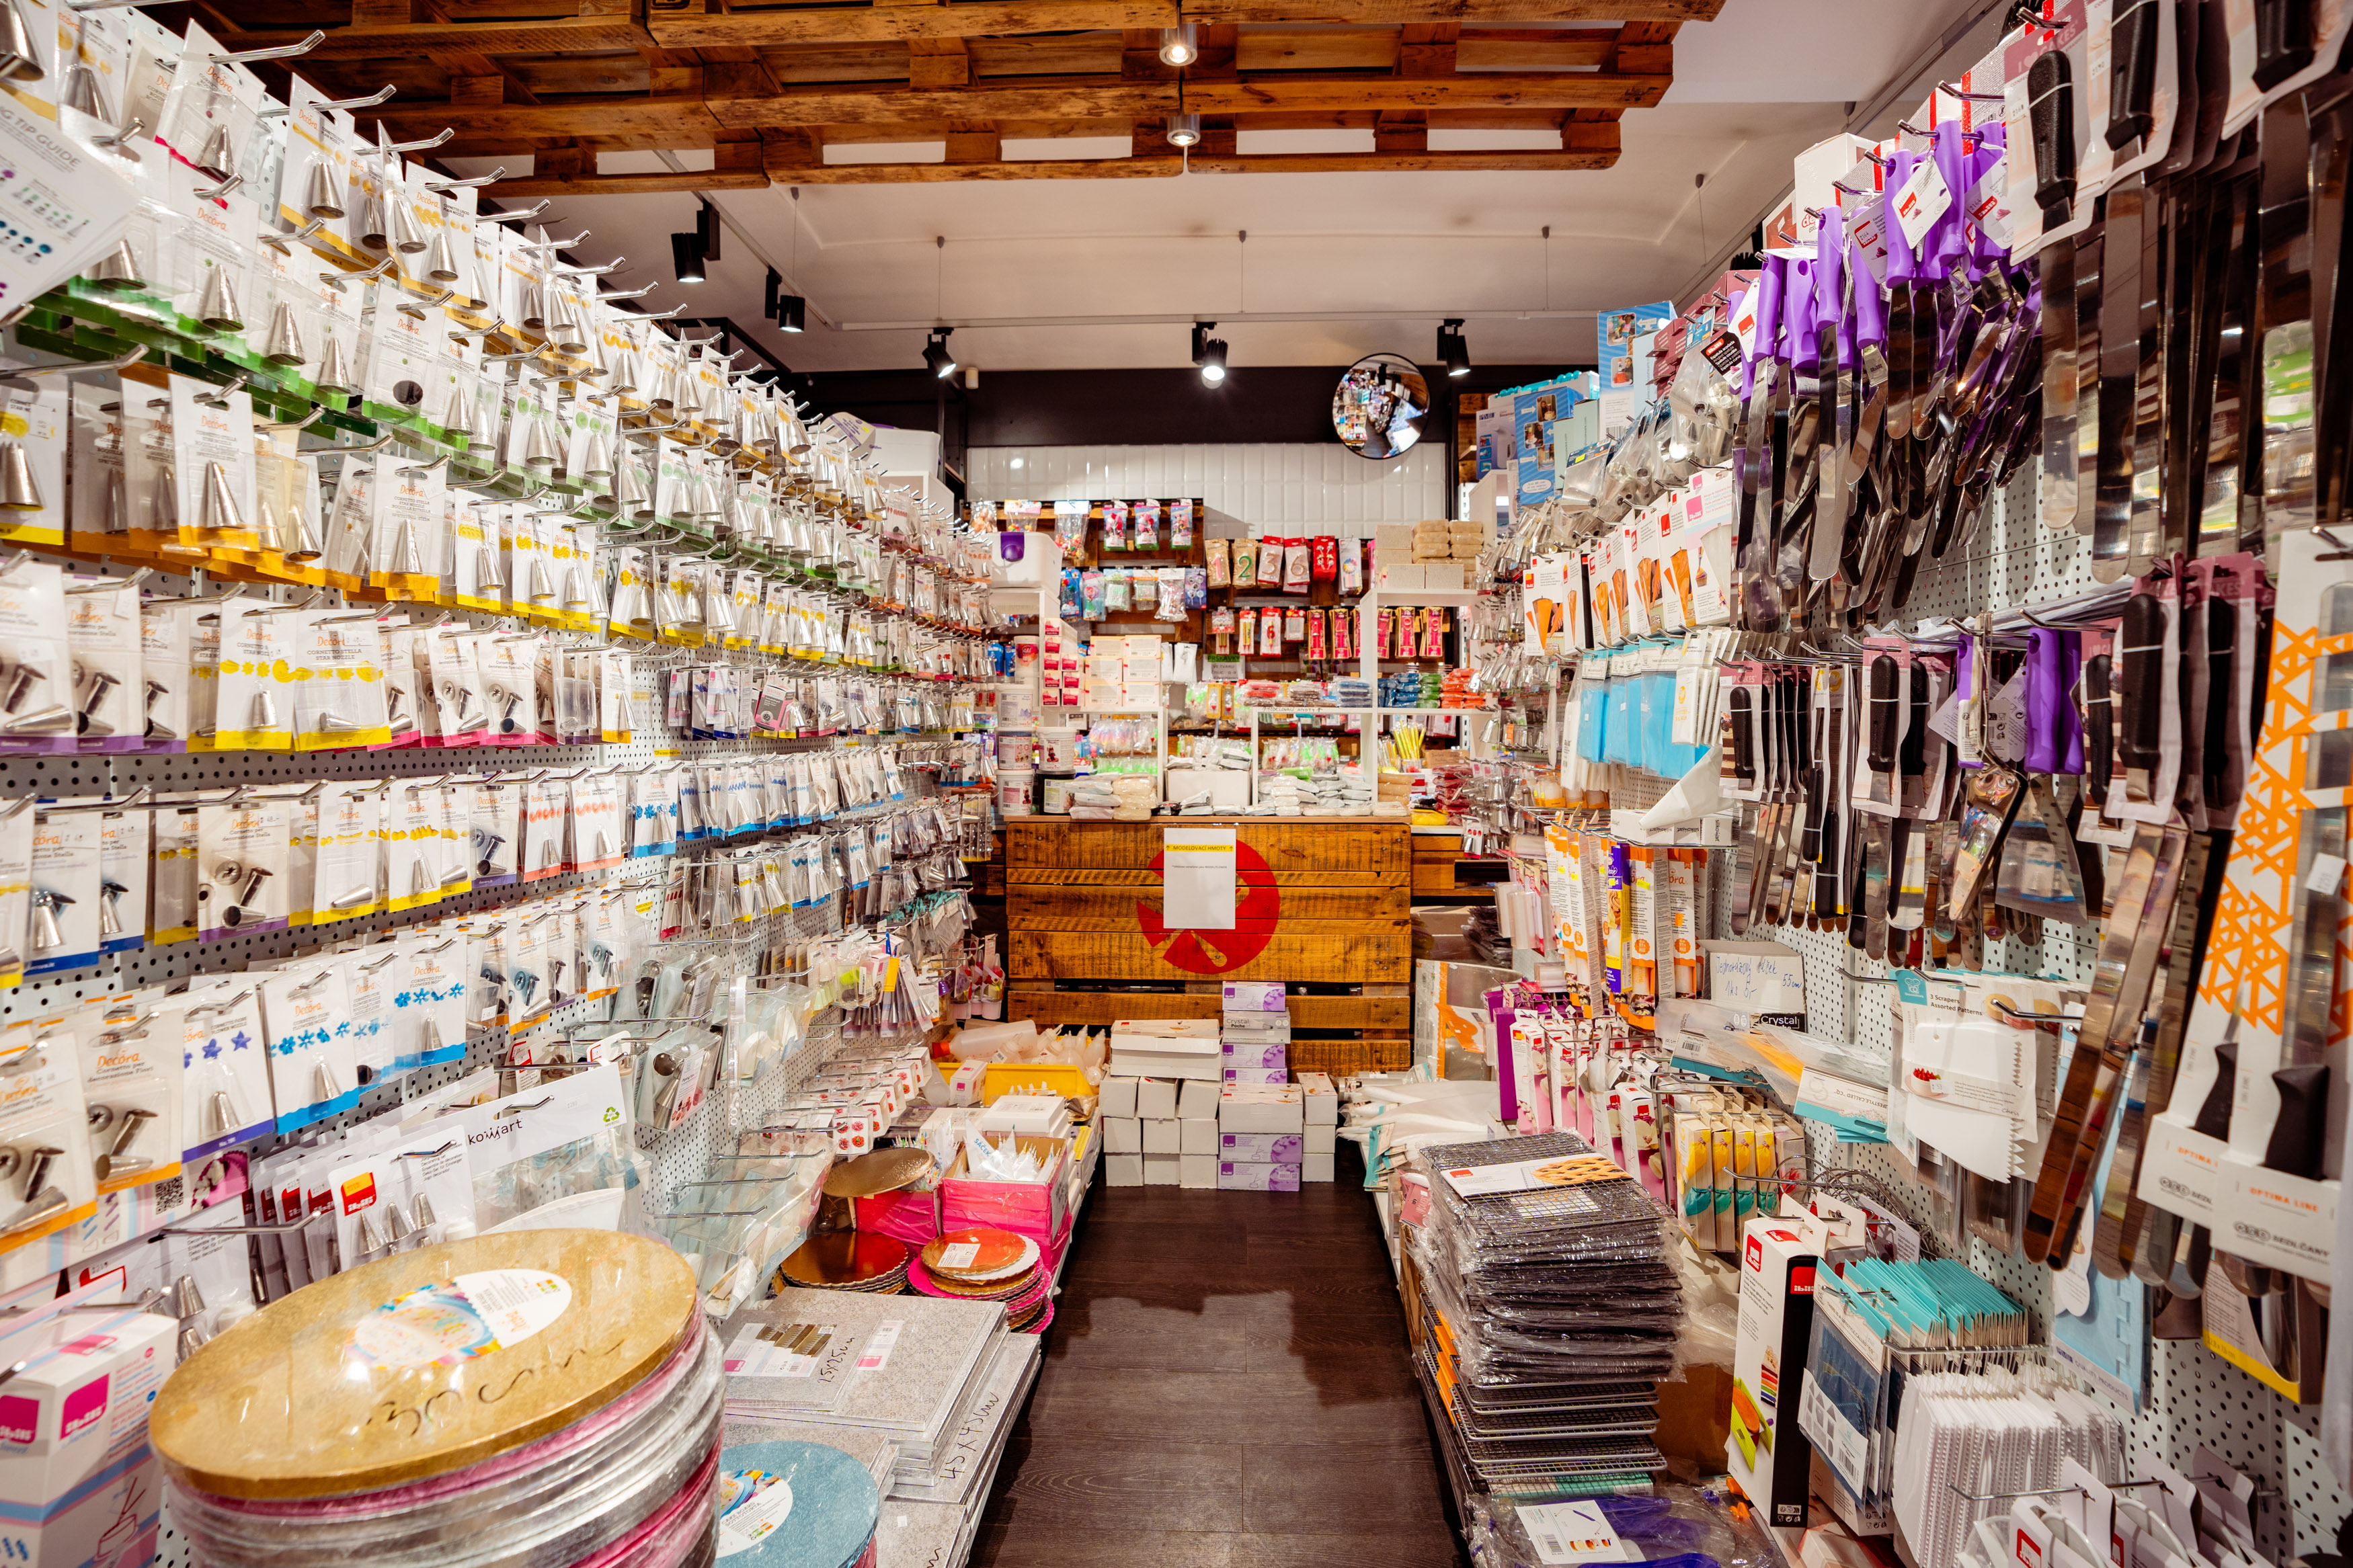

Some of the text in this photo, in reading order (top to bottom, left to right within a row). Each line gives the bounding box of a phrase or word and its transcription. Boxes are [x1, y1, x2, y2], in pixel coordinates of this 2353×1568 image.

[36, 135, 81, 167] GUIDE
[1931, 1002, 1983, 1016] Assorted Patterns
[1935, 995, 1960, 1005] Scrapers
[1760, 1016, 1798, 1026] Crystal
[468, 1118, 523, 1146] komart
[973, 1138, 991, 1157] SÁČEK
[2191, 1190, 2213, 1205] SEDL
[2249, 1186, 2319, 1213] OPTIMA LINE
[1747, 1254, 1761, 1271] ibili
[2097, 1375, 2130, 1402] PRODUCTS
